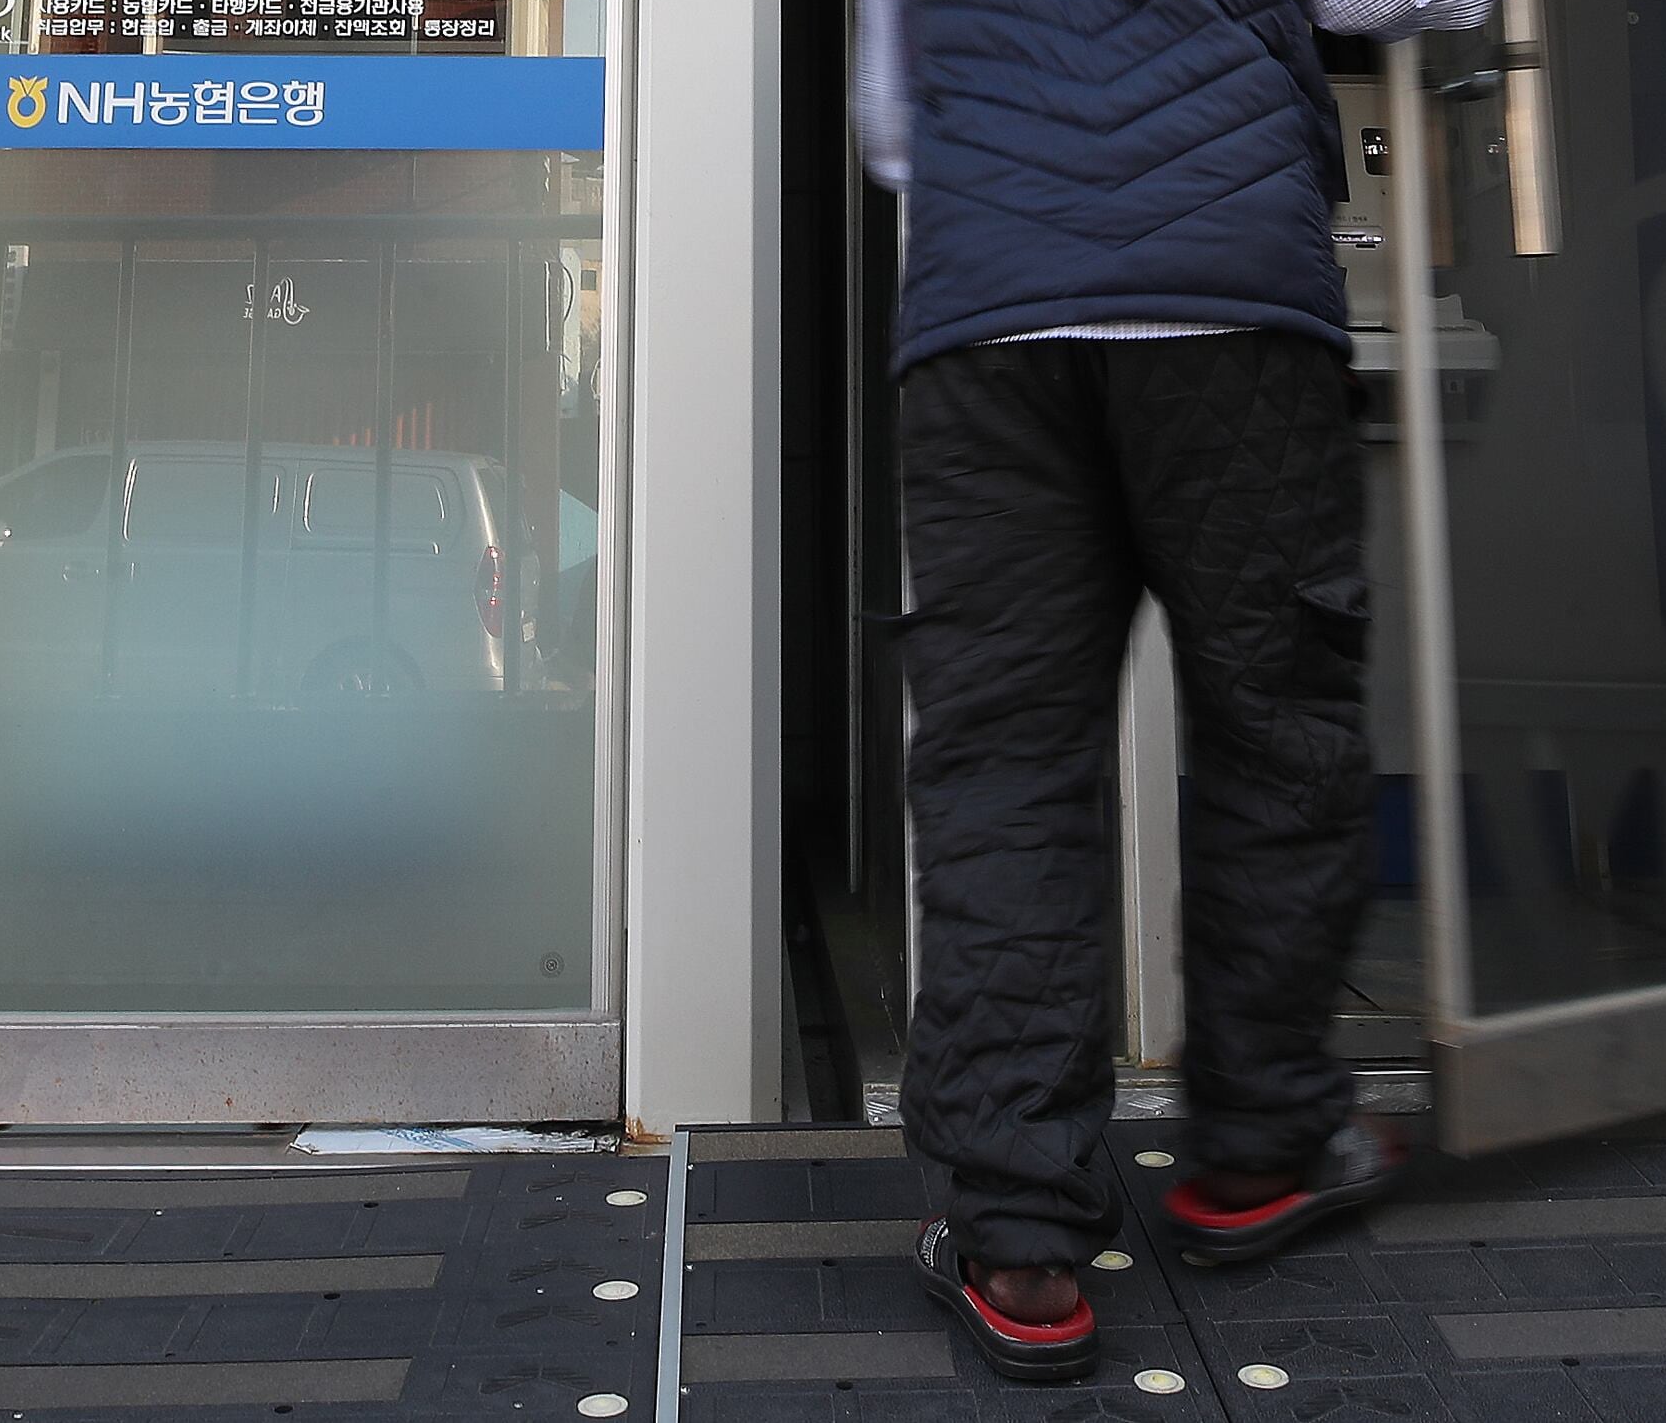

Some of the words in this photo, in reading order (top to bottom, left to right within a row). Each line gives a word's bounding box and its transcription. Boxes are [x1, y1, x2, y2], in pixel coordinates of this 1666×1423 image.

[193, 19, 228, 37] 출금
[245, 19, 316, 37] 계좌이체
[334, 19, 406, 37] 잔액조회
[424, 19, 495, 37] 통장정리
